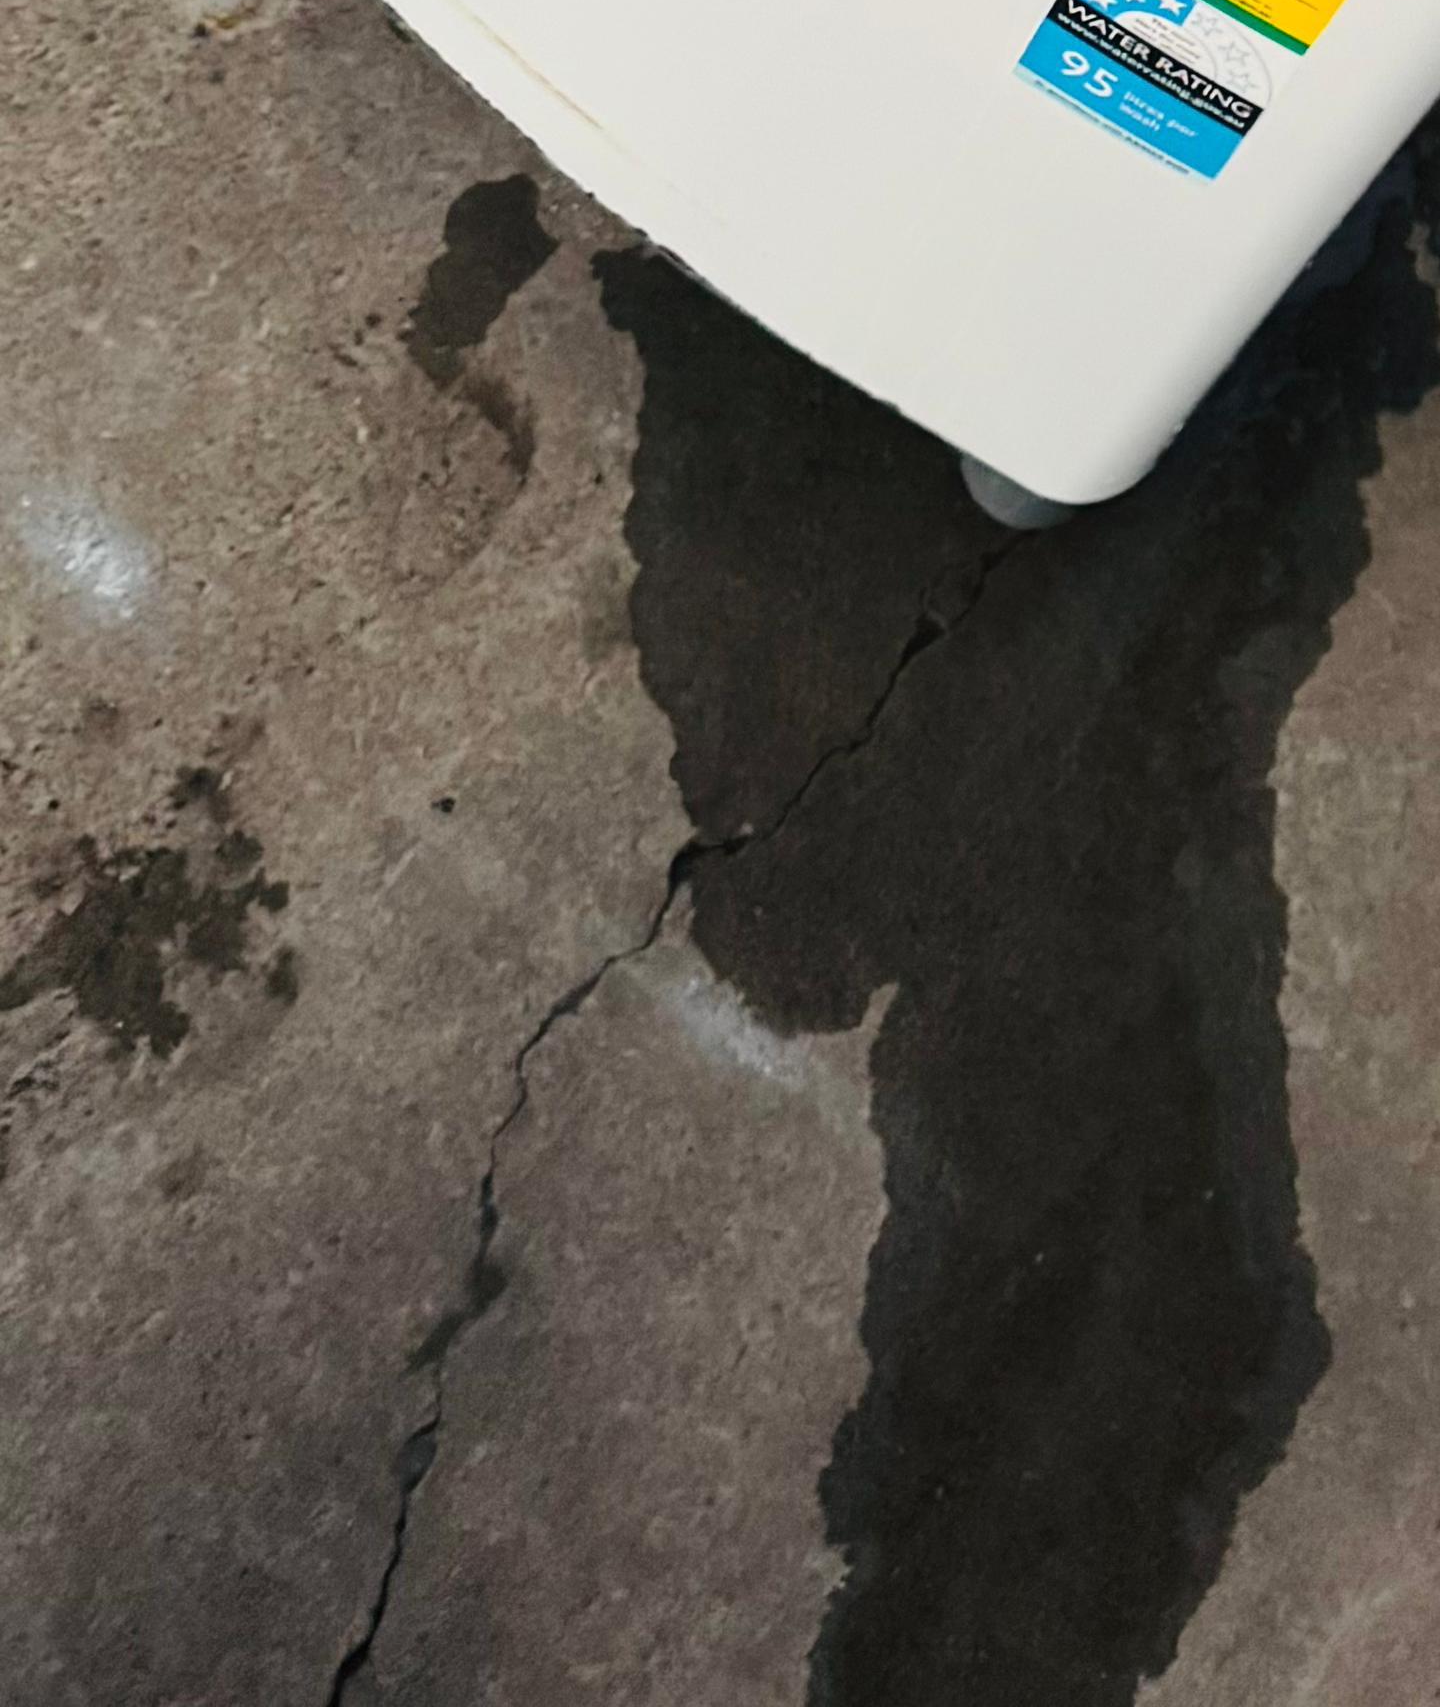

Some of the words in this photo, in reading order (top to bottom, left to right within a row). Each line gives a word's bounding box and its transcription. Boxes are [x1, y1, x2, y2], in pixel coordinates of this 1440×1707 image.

[1053, 45, 1121, 102] 95
[1122, 90, 1166, 121] litres
[1165, 117, 1199, 139] per
[1116, 101, 1161, 132] wash
[1154, 55, 1254, 120] RATING
